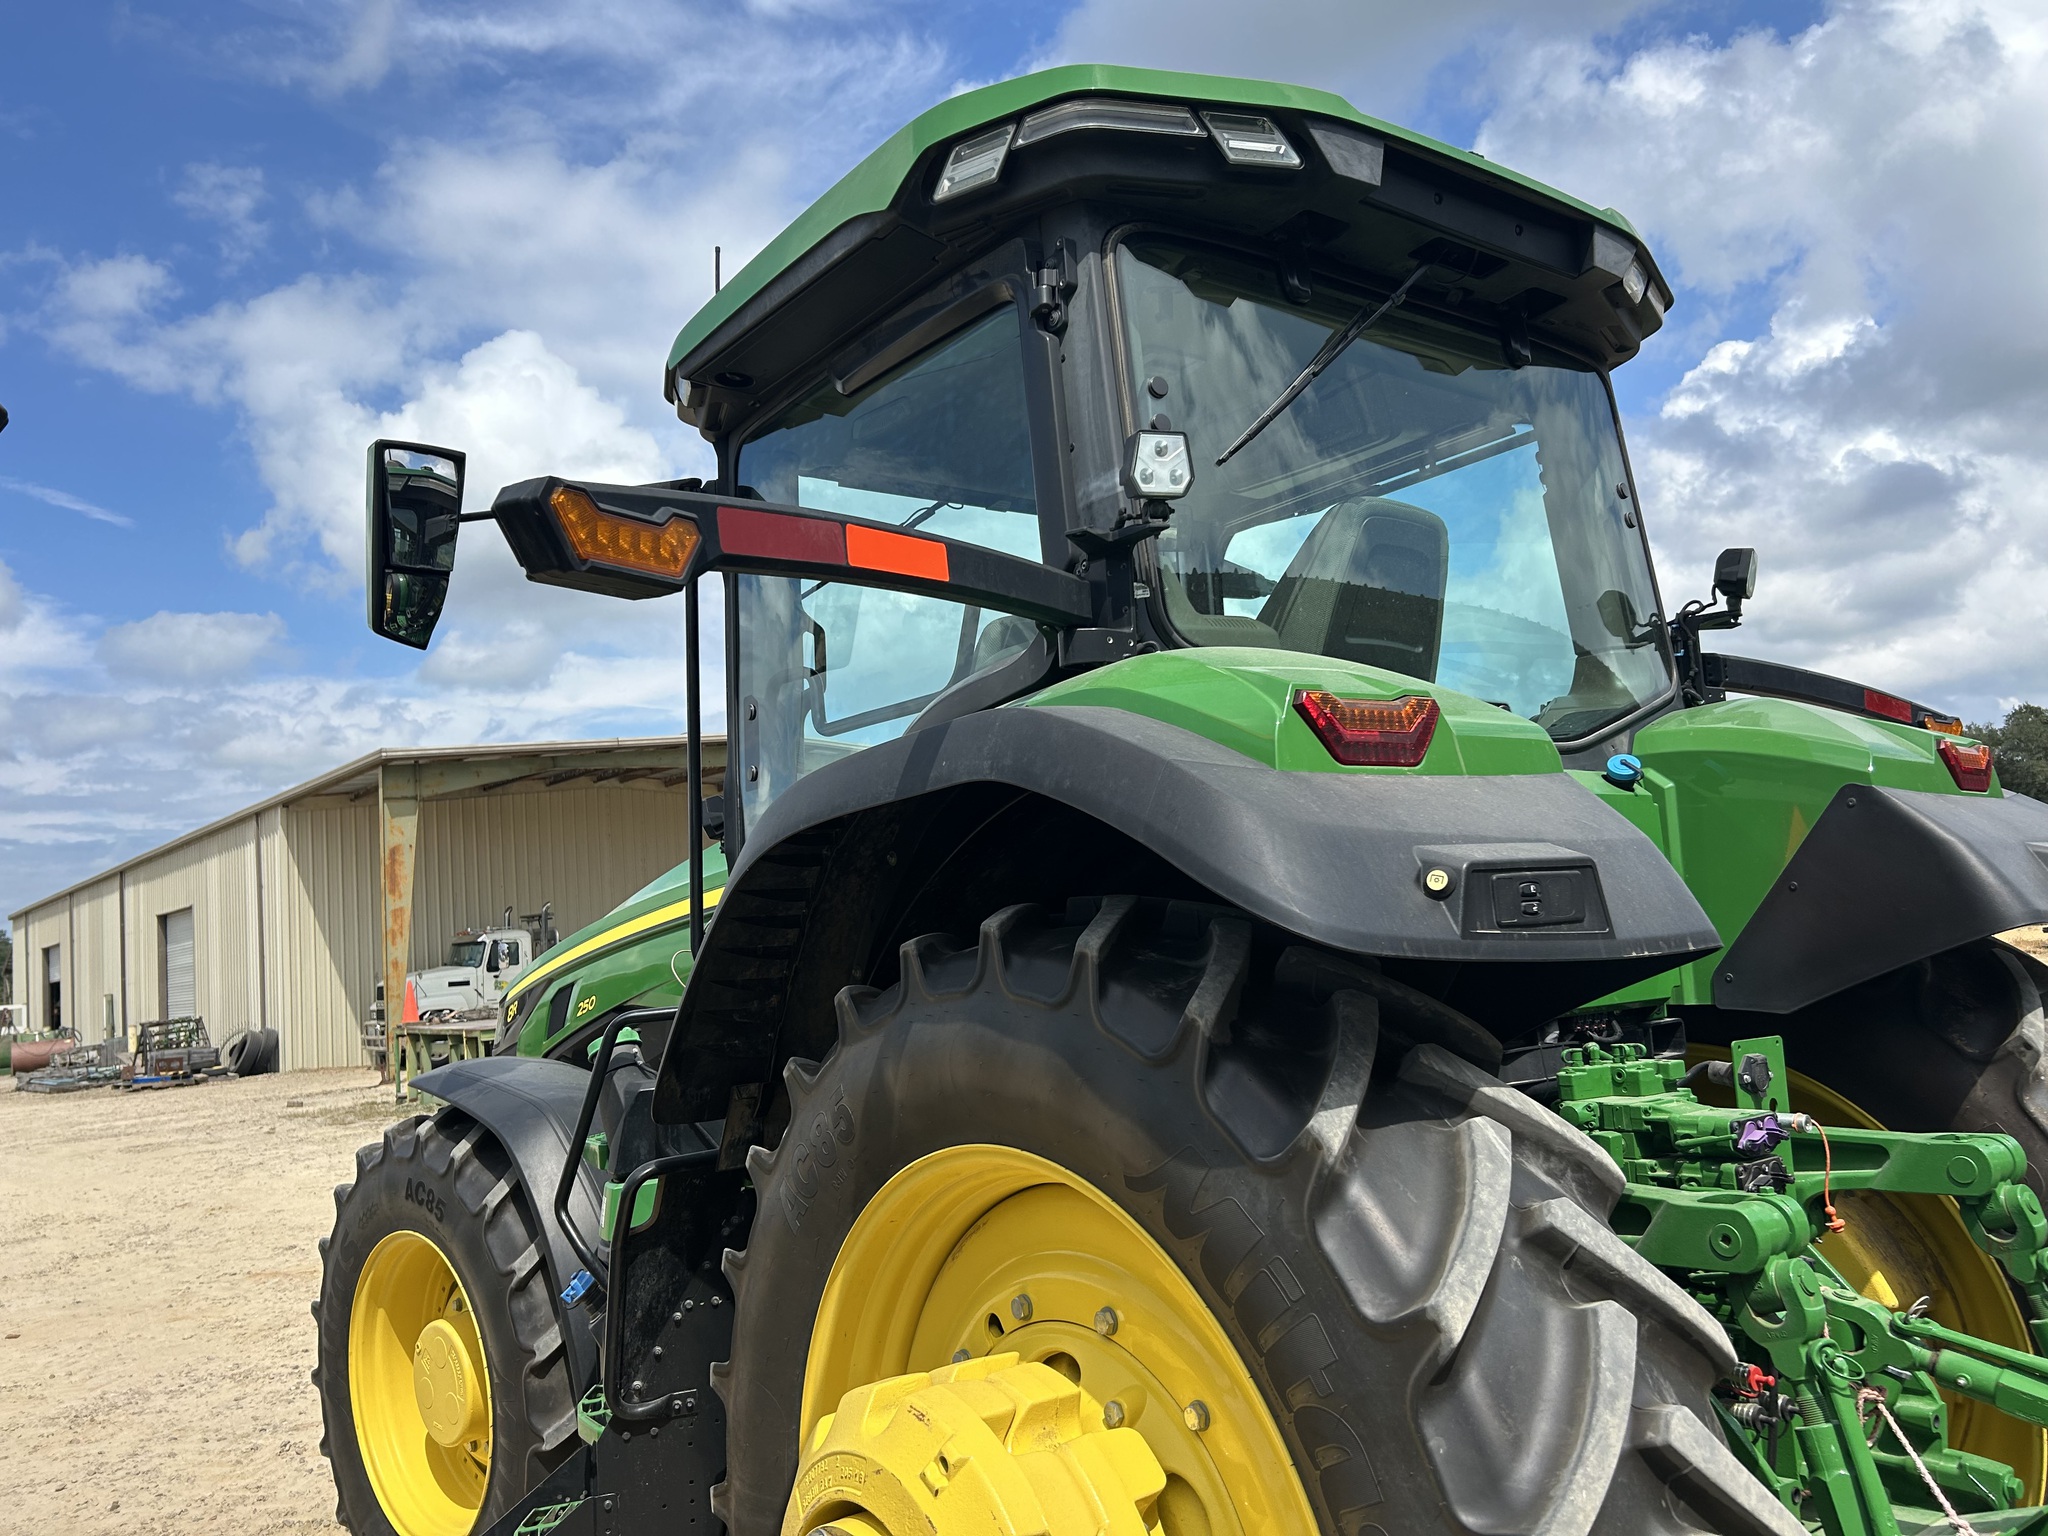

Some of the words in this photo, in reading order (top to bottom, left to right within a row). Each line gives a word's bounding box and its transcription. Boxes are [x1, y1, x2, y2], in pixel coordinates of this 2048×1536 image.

[507, 1000, 518, 1023] 8R
[576, 995, 596, 1017] 250
[780, 1084, 856, 1235] AC85
[404, 1176, 447, 1223] AC85
[1124, 1144, 1389, 1536] Mita
